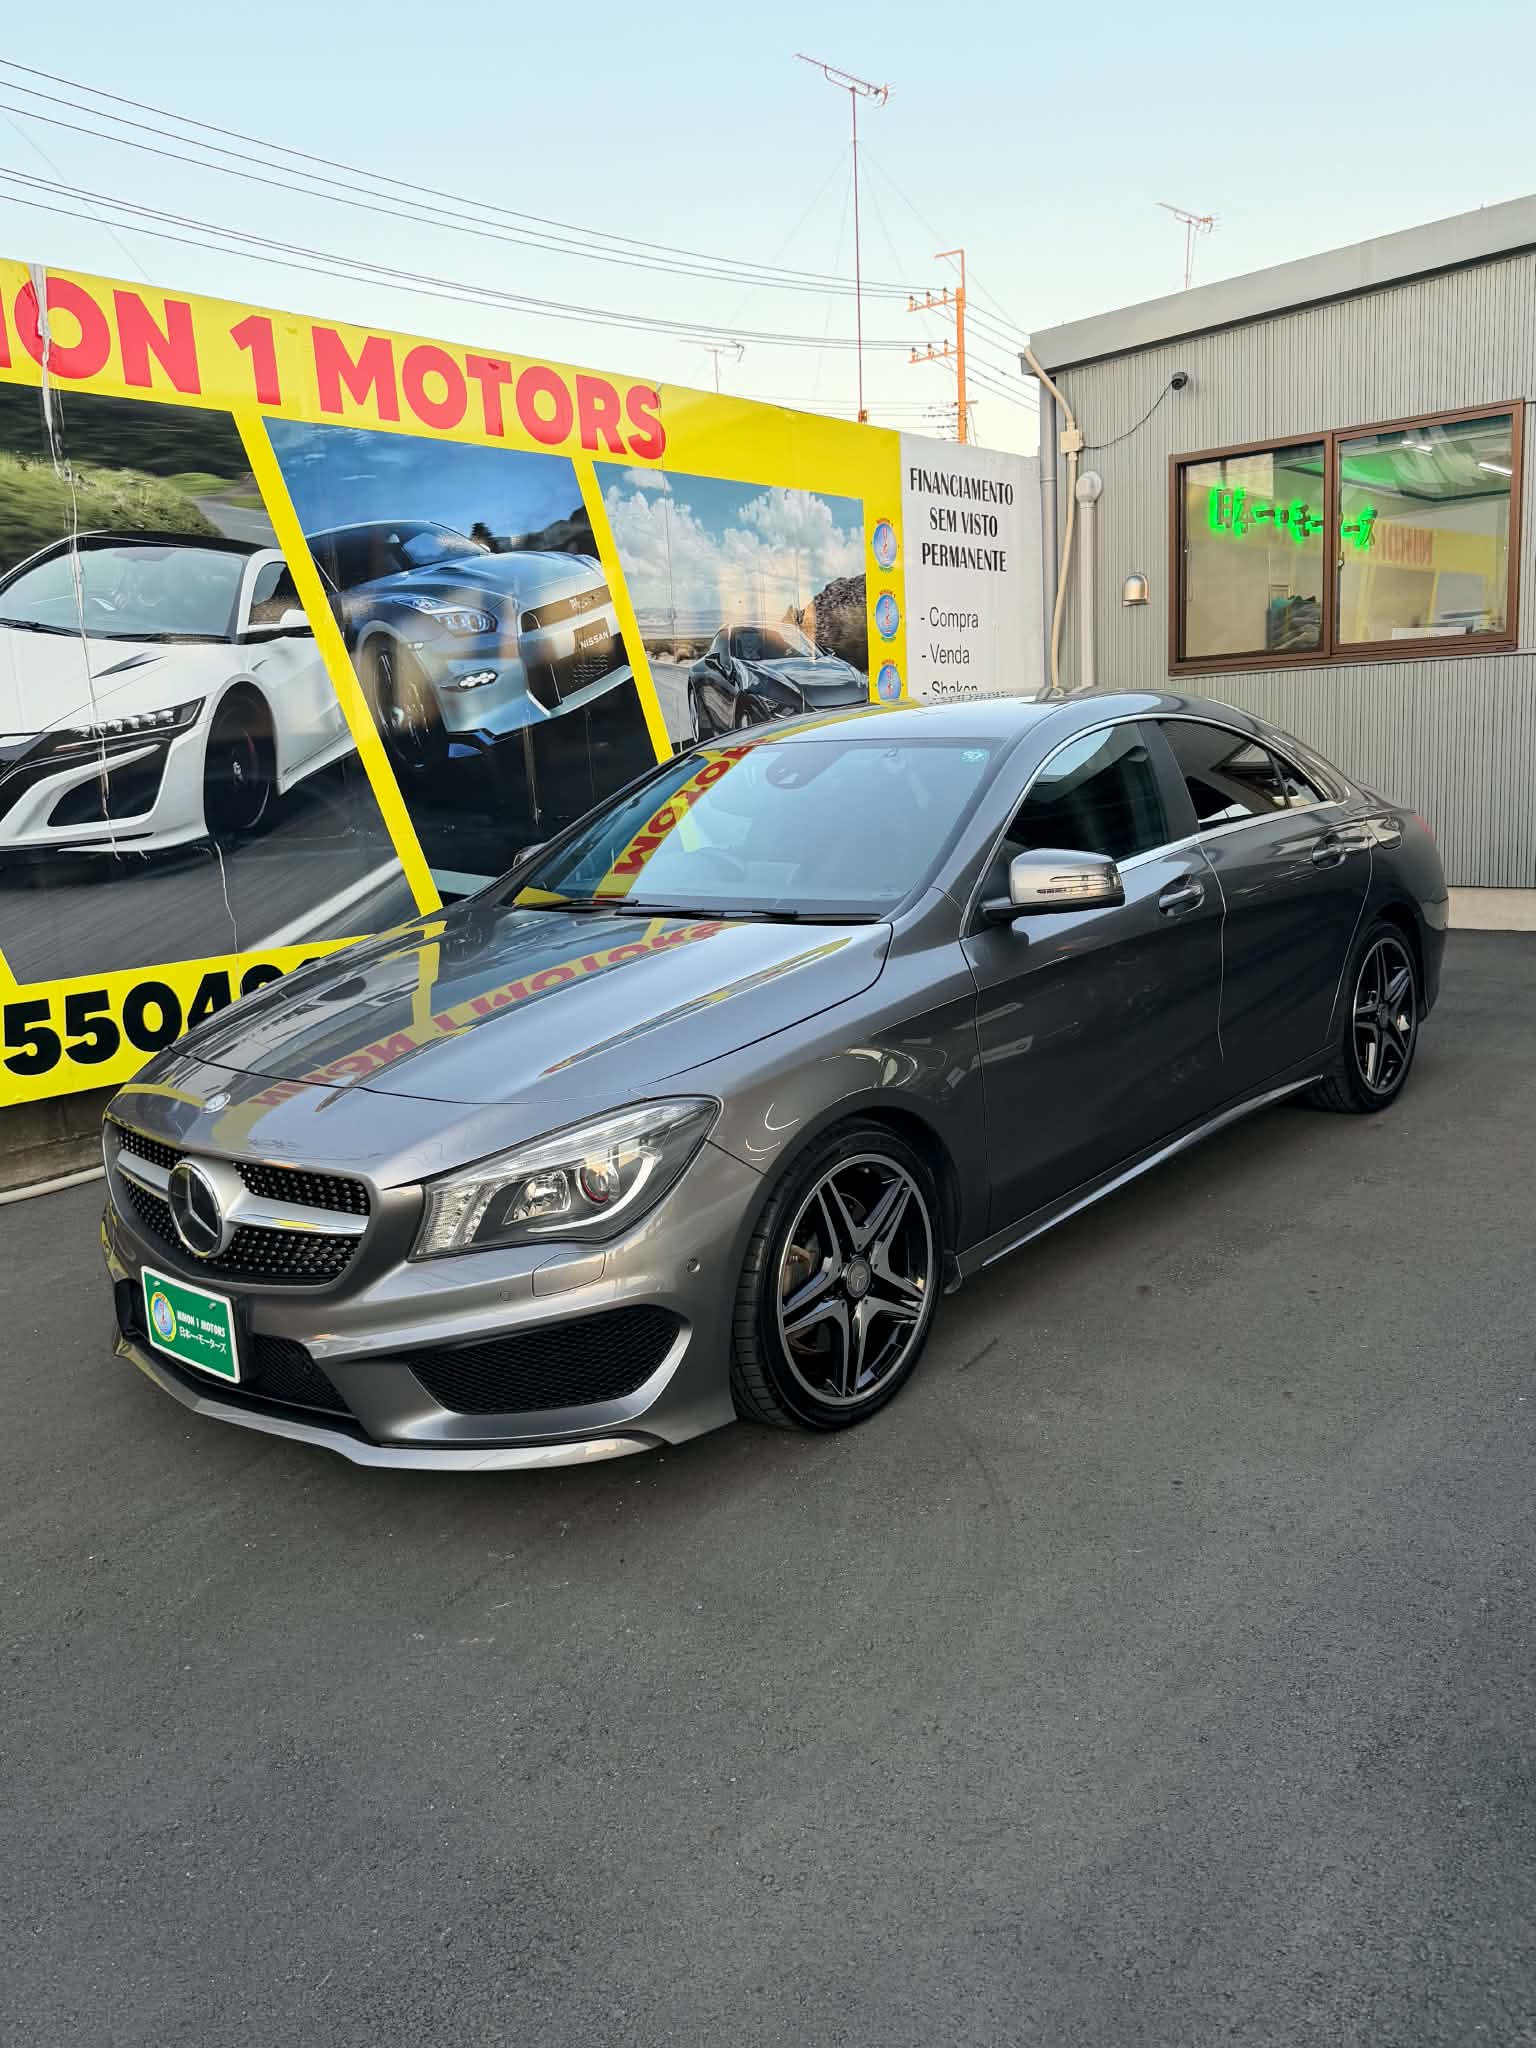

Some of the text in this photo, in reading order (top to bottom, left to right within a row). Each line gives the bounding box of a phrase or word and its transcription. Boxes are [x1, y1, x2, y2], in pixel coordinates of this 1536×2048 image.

[230, 315, 281, 406] 1
[312, 325, 666, 460] MOTORS
[910, 467, 1014, 505] FINANCIAMENTO
[930, 507, 998, 537] SEM VISTO
[922, 542, 1007, 572] PERMANENTE
[929, 606, 979, 633] Compra
[580, 631, 610, 650] NISSAN
[930, 643, 970, 664] Venda
[200, 1319, 226, 1337] MOTORS
